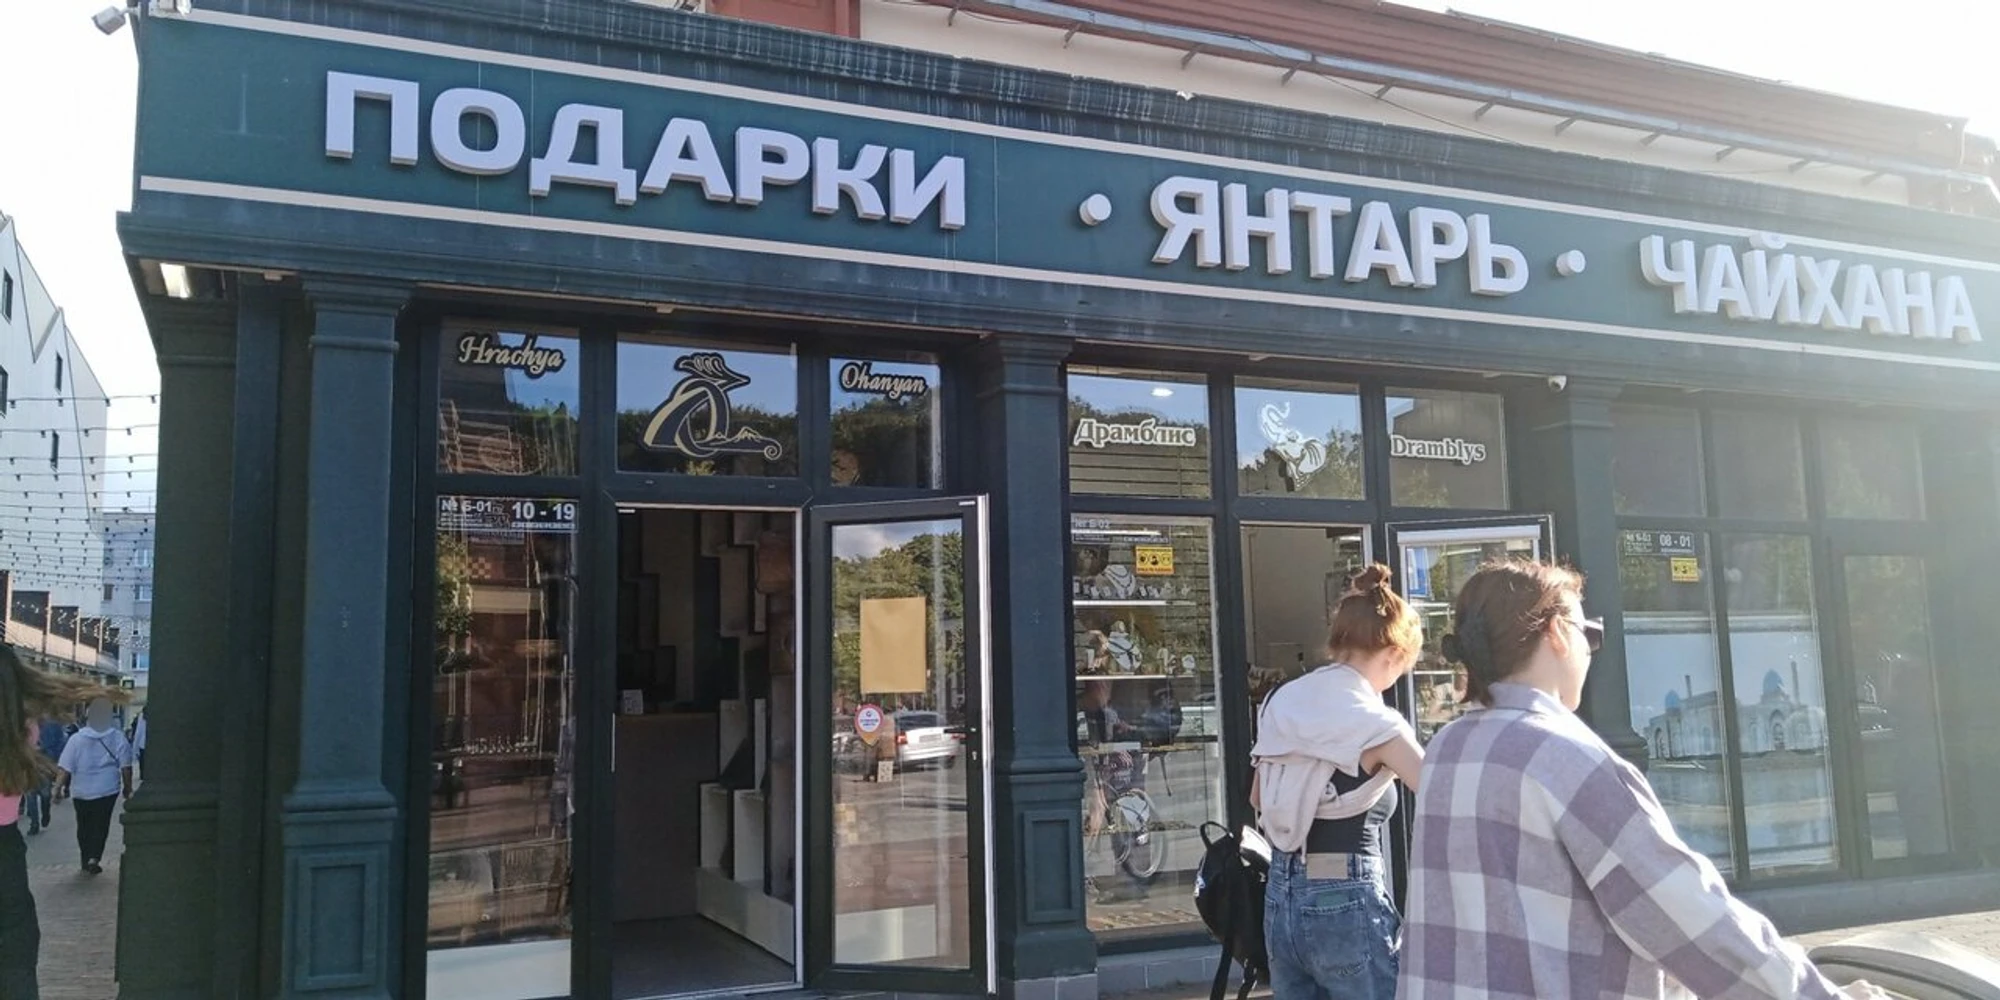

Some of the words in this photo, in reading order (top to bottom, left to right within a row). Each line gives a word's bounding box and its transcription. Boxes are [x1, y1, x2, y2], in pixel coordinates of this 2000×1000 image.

[325, 70, 966, 230] ПОДАРКИ
[1150, 176, 1529, 297] ЯНТАРЬ
[1639, 231, 1983, 344] ЧАЙХАНА
[459, 335, 563, 375] Hrachya
[842, 364, 926, 400] Ohanyan
[1073, 418, 1197, 448] Драмблис
[1390, 434, 1487, 465] Dramblys
[512, 501, 535, 519] 10
[552, 503, 576, 520] 19
[1659, 534, 1673, 547] 08
[1680, 535, 1691, 548] 01
